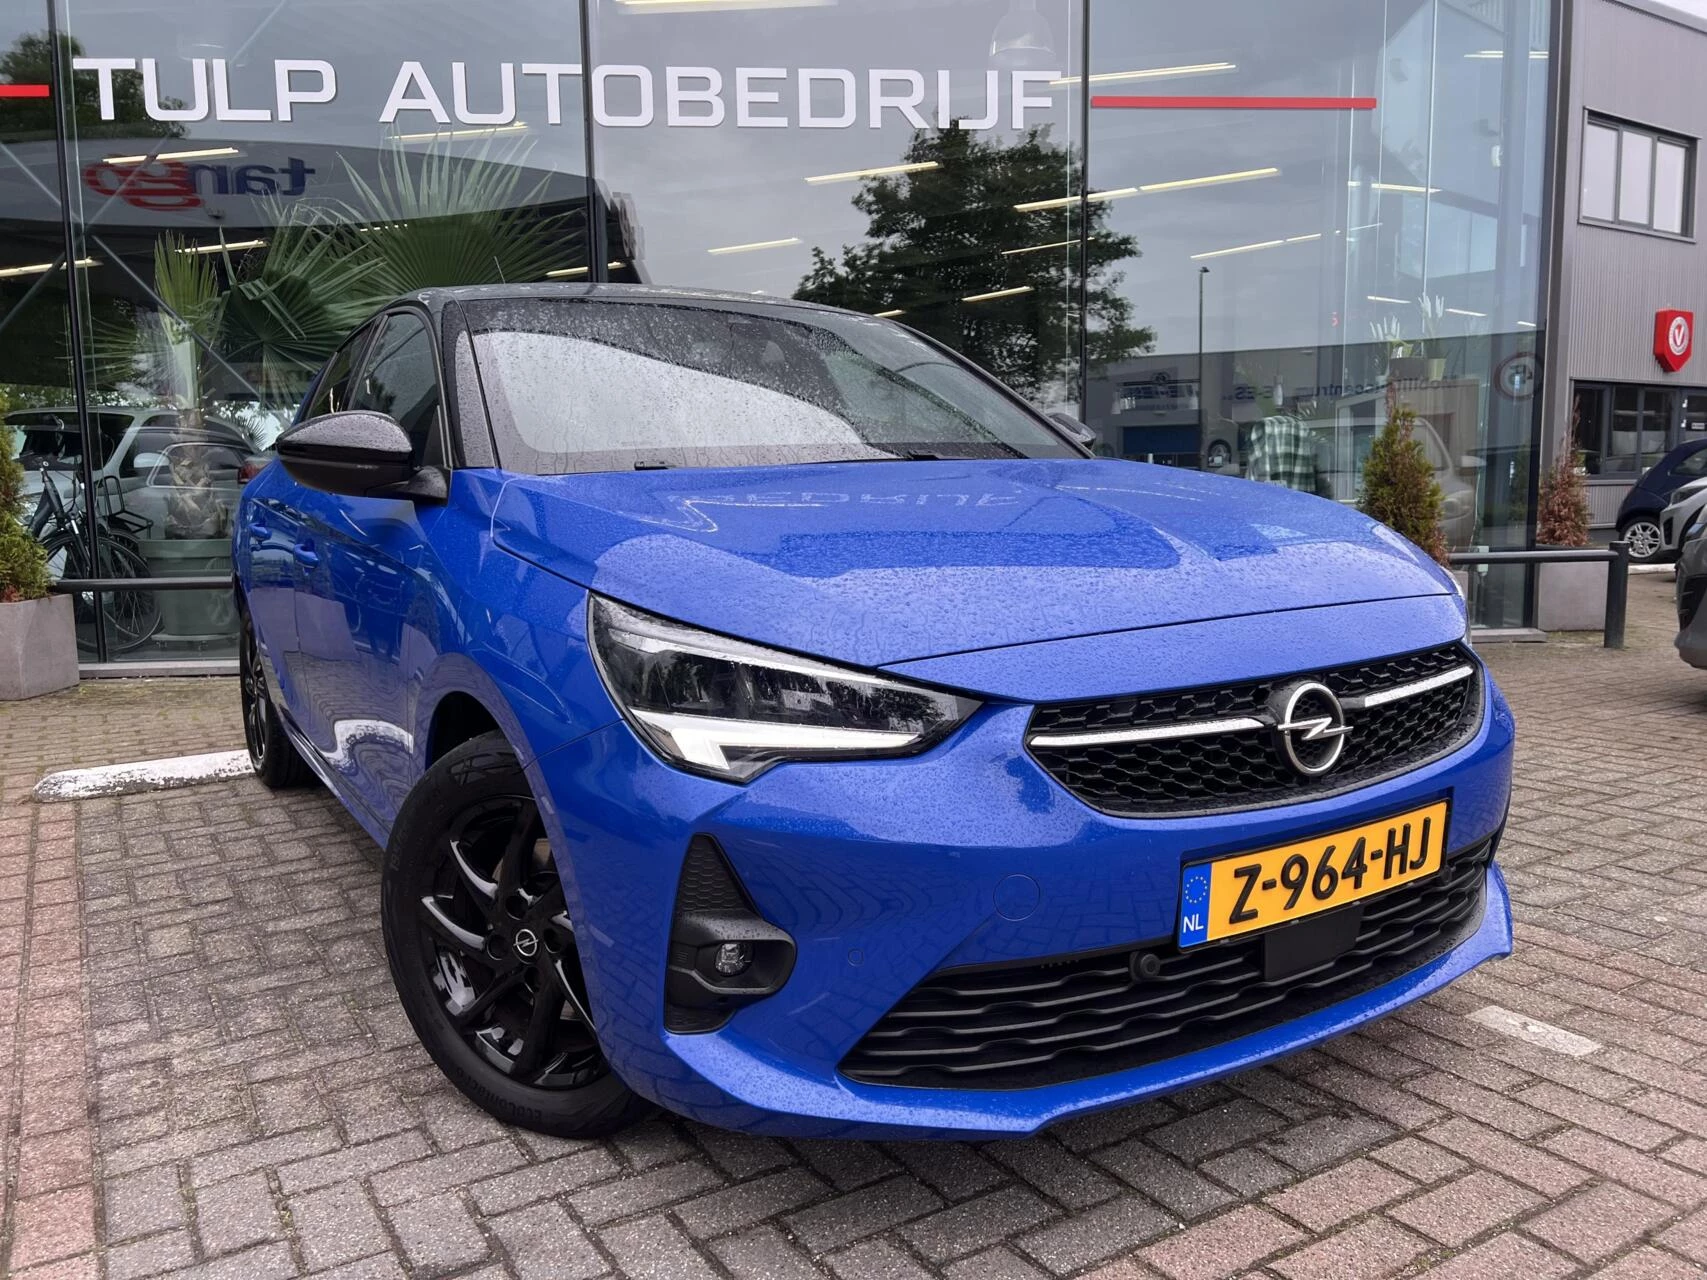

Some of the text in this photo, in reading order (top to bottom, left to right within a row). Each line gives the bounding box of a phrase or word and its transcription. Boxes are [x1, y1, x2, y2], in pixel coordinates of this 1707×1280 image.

[72, 58, 1063, 130] TULP AUTOBEDRIJF
[1228, 816, 1431, 925] Z-964-HJ
[1182, 913, 1205, 934] NL
